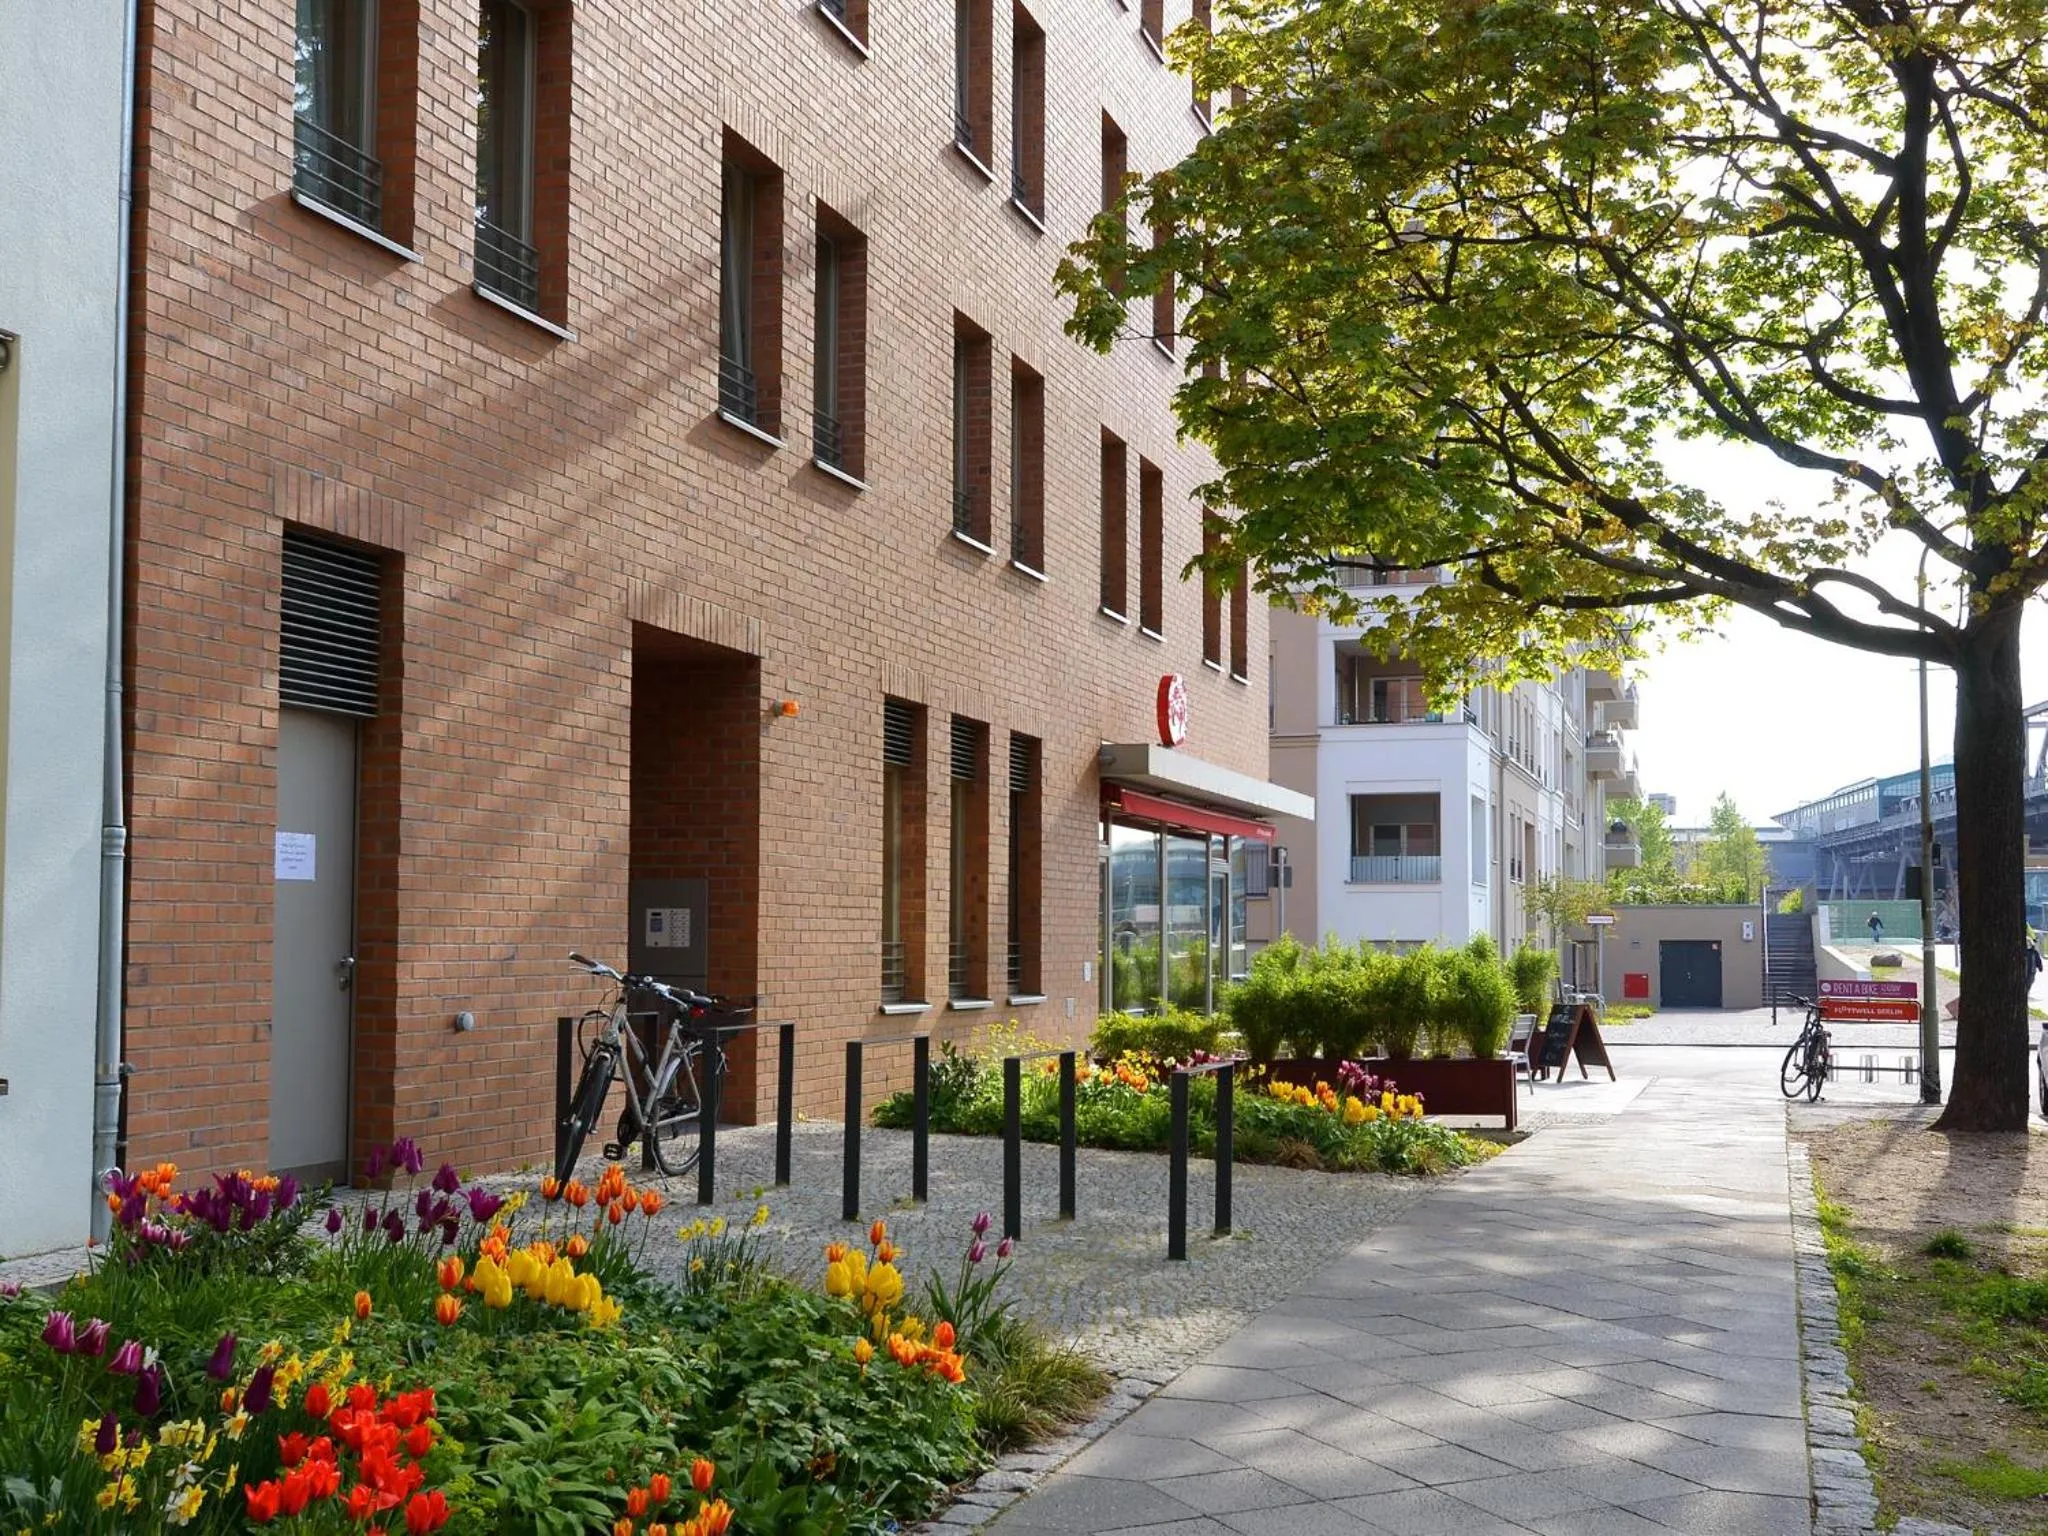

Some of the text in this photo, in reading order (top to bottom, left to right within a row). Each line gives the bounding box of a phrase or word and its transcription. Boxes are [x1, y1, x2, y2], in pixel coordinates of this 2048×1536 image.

[1833, 982, 1852, 994] RENT
[1853, 983, 1861, 995] A
[1861, 983, 1878, 995] BIKE
